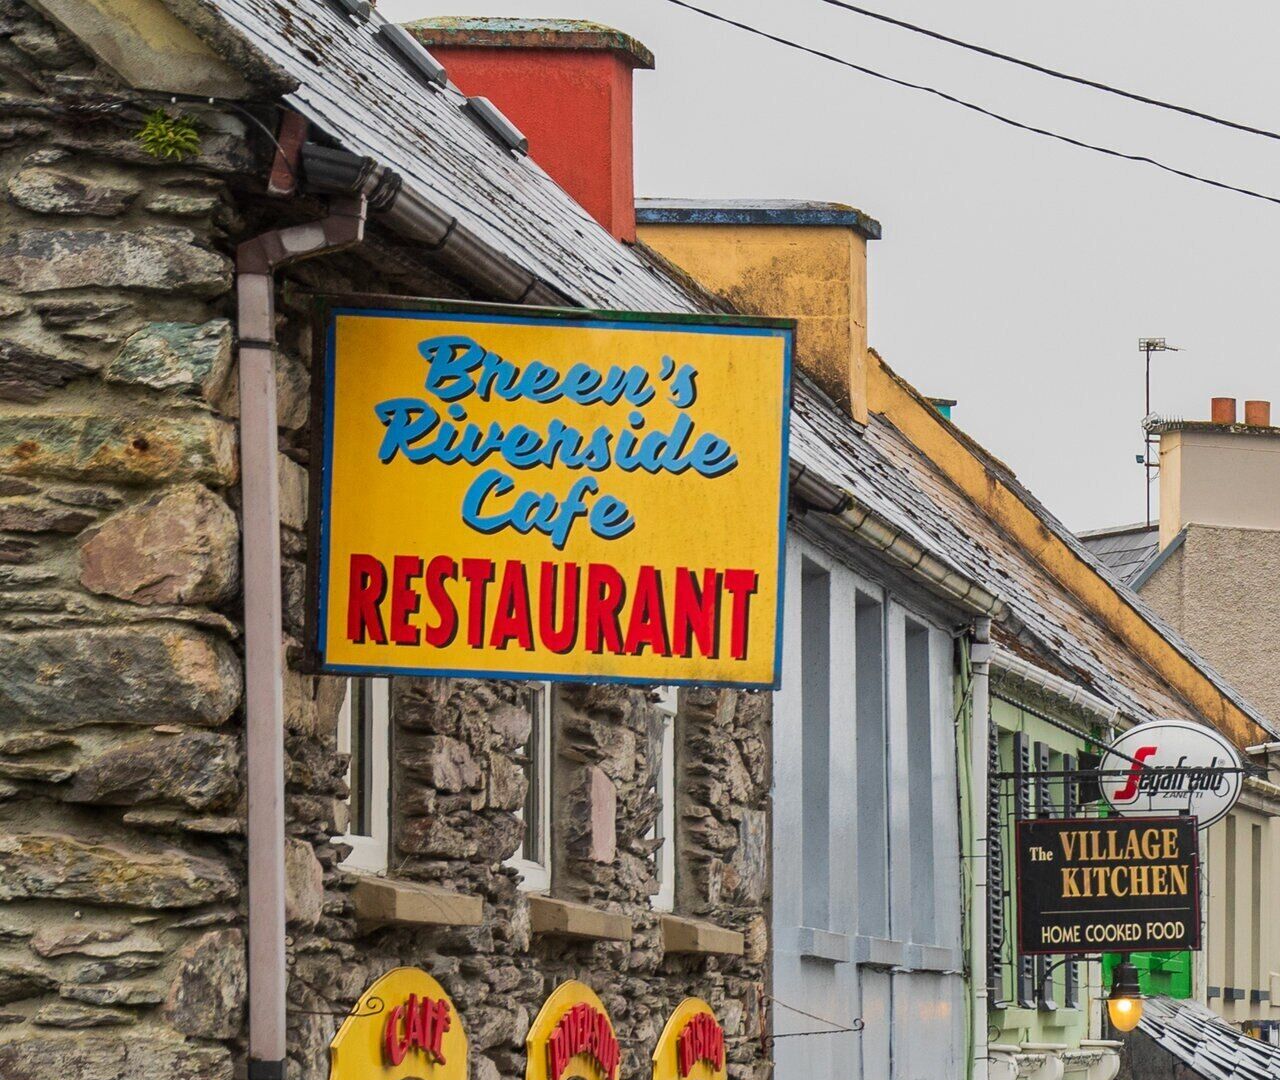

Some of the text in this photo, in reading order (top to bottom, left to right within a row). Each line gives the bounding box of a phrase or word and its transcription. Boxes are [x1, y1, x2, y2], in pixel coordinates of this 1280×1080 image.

[417, 334, 699, 409] Breen's
[374, 396, 739, 478] Riverside
[459, 467, 637, 550] Cafe
[346, 552, 759, 661] RESTAURANT
[1163, 791, 1204, 799] ZANETI
[1029, 828, 1180, 862] The VILLAGE
[1060, 864, 1189, 898] KITCHEN
[1041, 921, 1185, 944] HOME COOKED FOOD
[385, 992, 452, 1067] CAFE
